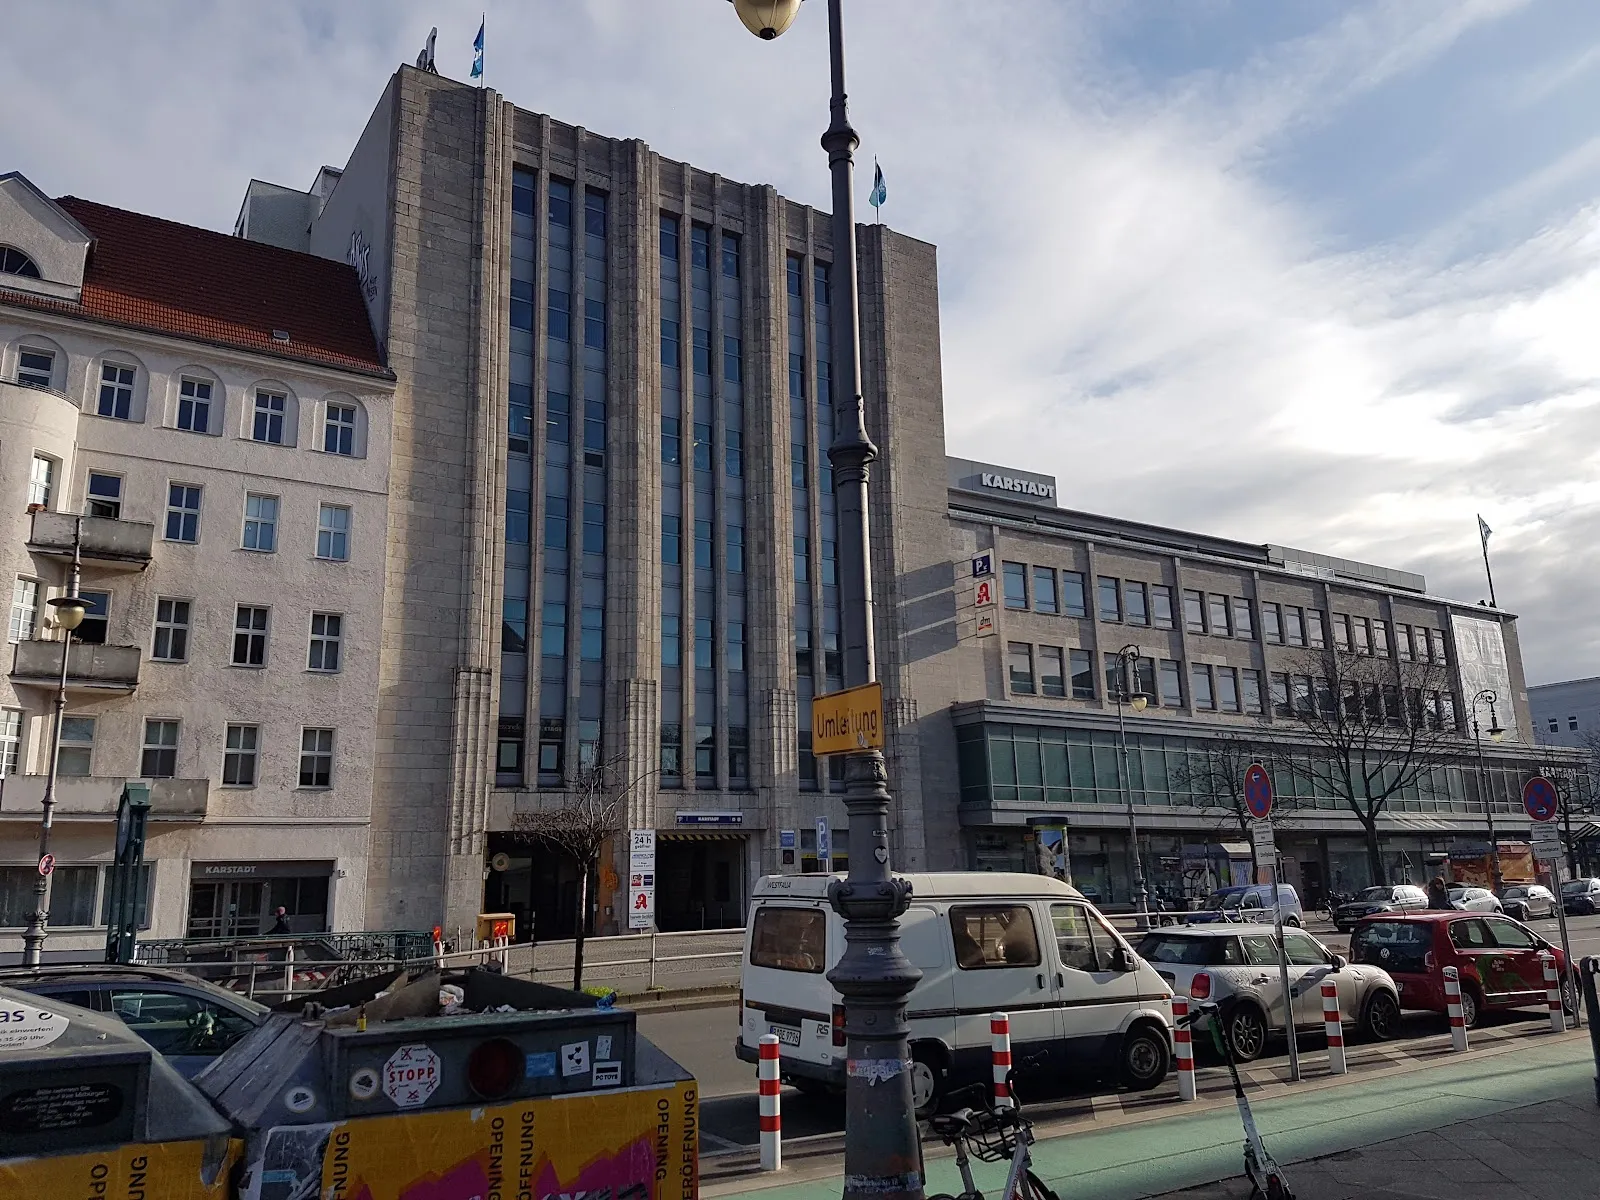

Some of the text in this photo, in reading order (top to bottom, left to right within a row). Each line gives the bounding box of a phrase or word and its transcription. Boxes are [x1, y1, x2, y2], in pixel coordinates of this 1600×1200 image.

[981, 472, 1055, 498] KARSTADT
[980, 616, 991, 626] dm
[816, 708, 878, 739] Umleitung
[634, 836, 652, 844] 24 h
[205, 865, 257, 874] KARSTADT
[767, 881, 792, 889] WESTFALIA
[816, 1024, 830, 1035] RS
[389, 1067, 435, 1083] STOPP
[656, 1098, 670, 1181] OPENING
[680, 1089, 696, 1200] ERÖFFNUNG
